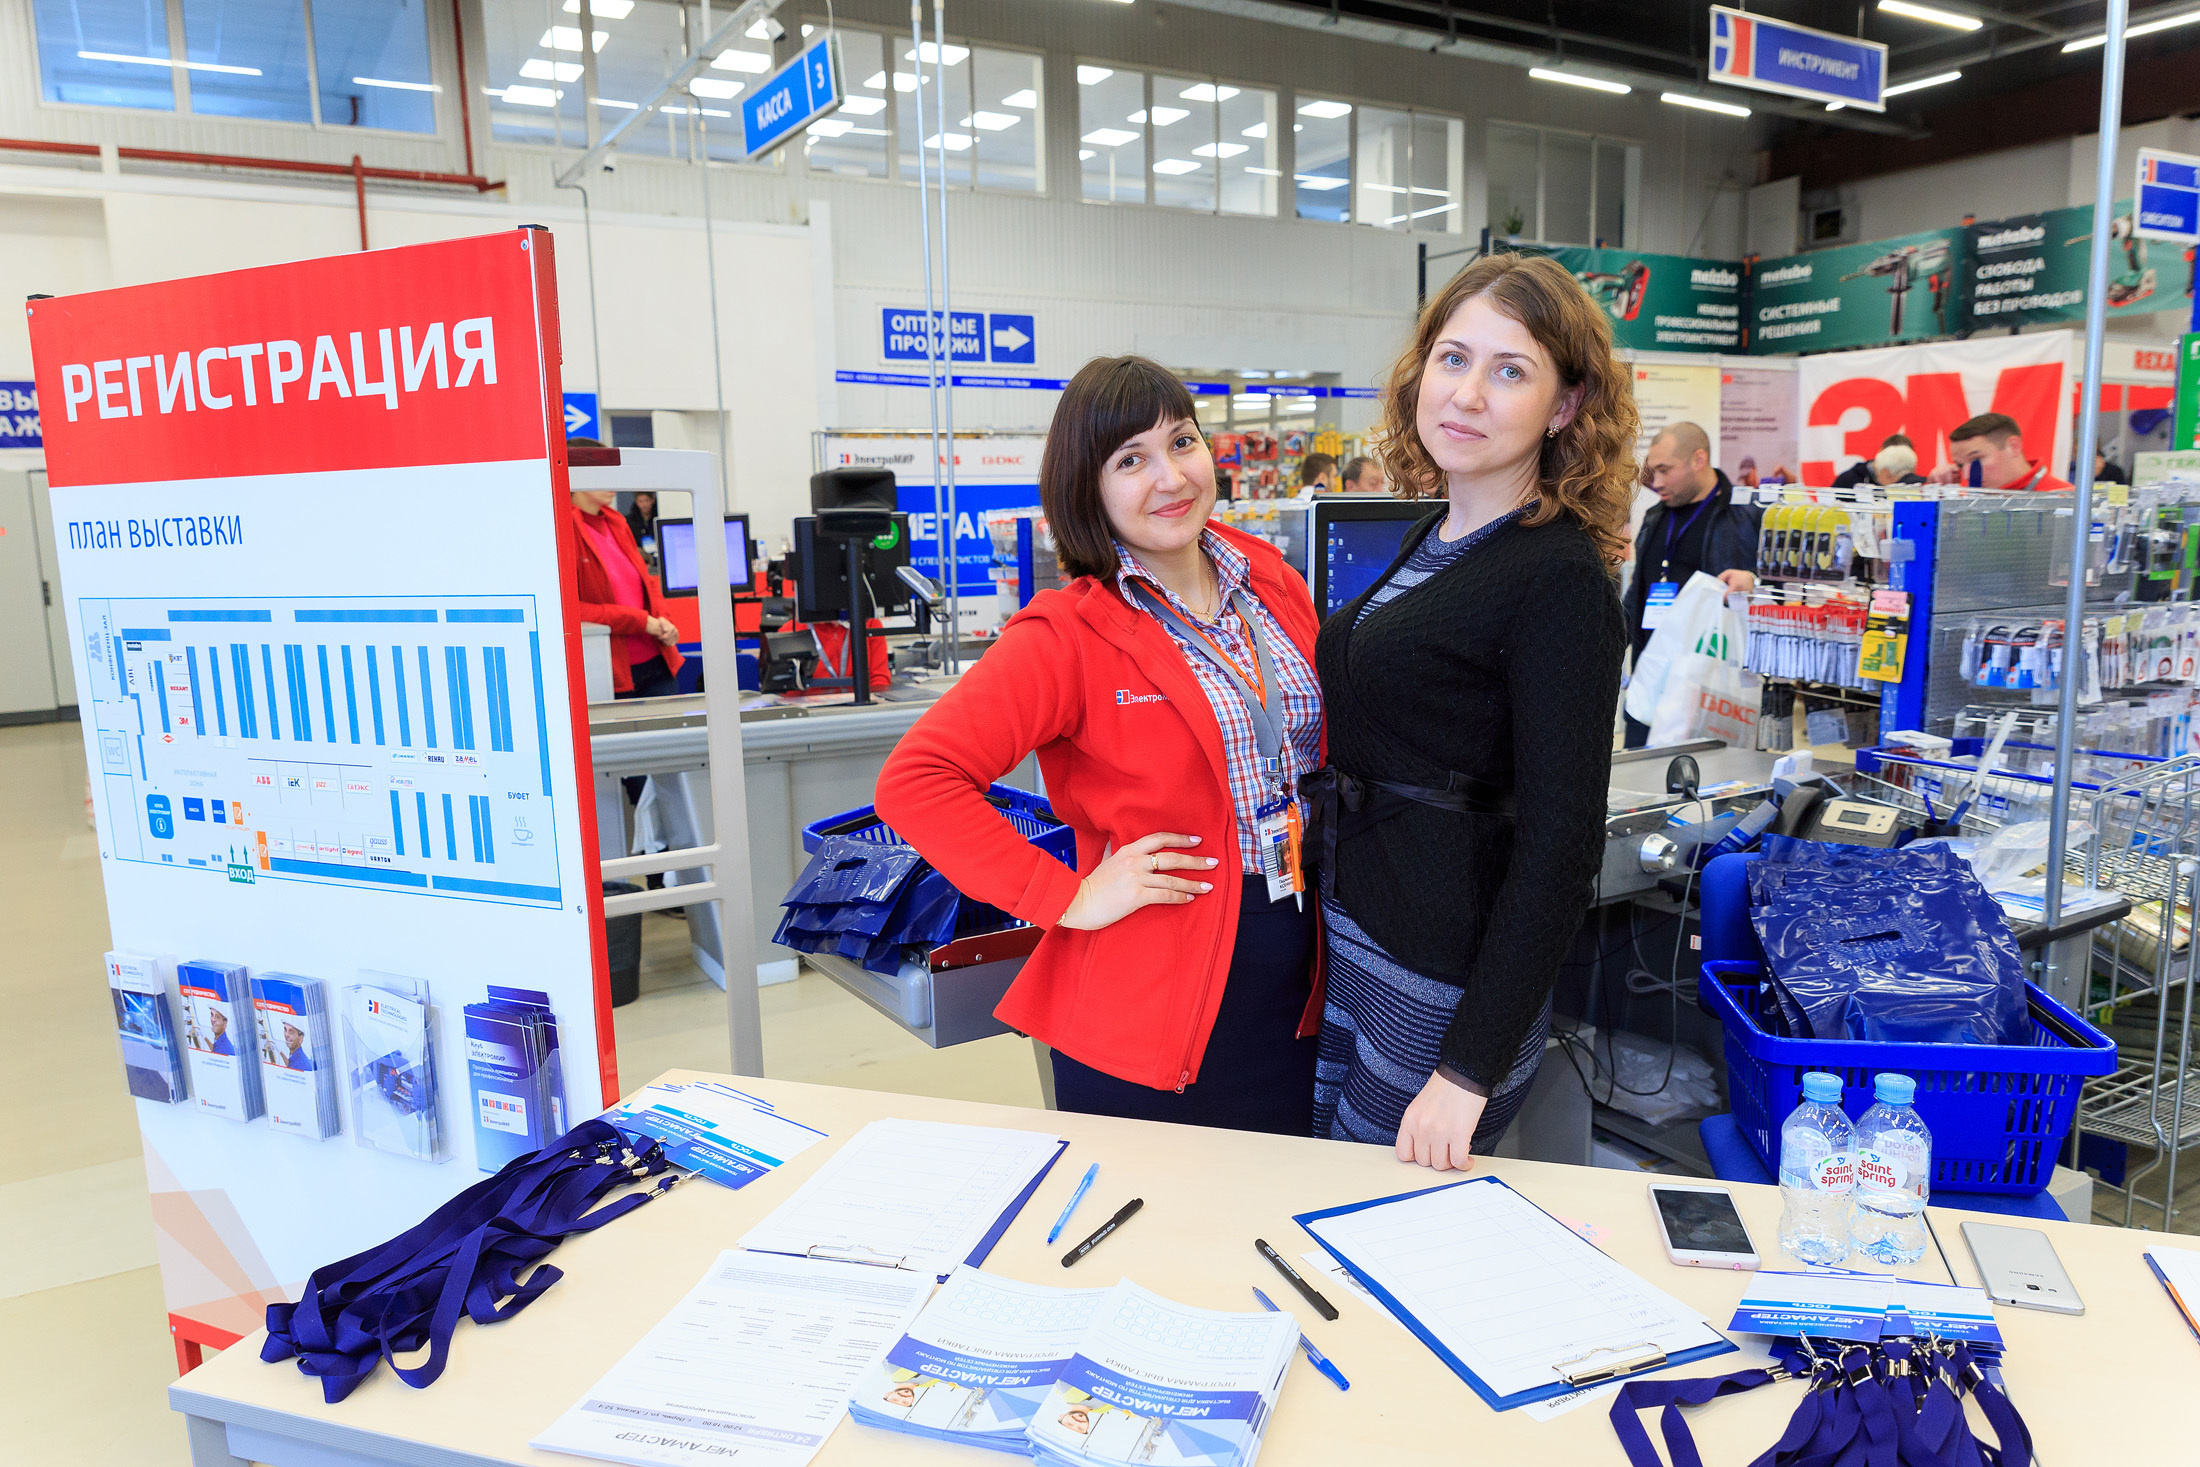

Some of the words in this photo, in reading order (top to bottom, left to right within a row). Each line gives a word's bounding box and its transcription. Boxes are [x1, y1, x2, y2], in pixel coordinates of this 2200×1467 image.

[1778, 47, 1860, 81] ИНСТРУМЕНТ
[756, 87, 793, 131] КАССА
[815, 62, 825, 89] 3
[1977, 226, 2045, 249] metabo
[1761, 264, 1813, 284] metabo
[1976, 257, 2045, 279] СВОБОДА
[1690, 267, 1738, 287] metabo
[1975, 277, 2034, 298] РАБОТЫ
[1759, 297, 1841, 321] СИСТЕМНЫЕ
[1973, 300, 2001, 316] БЕЗ
[2001, 290, 2083, 312] ПРОВОДОВ
[1759, 319, 1821, 340] РЕШЕНИЯ
[61, 316, 498, 424] РЕГИСТРАЦИЯ
[1802, 362, 2063, 487] 3M
[854, 454, 914, 466] ЭлектроМИР
[68, 522, 122, 551] план
[128, 514, 243, 549] выставки
[179, 717, 189, 725] 3M
[256, 776, 271, 785] ABB
[507, 791, 530, 801] БУФЕТ
[369, 837, 388, 847] gauss
[229, 867, 254, 883] ВХОД
[471, 1051, 506, 1061] ЭЛЕКТРОМИР
[683, 1113, 707, 1125] ГОСТЬ
[731, 1143, 754, 1155] ГОСТЬ
[690, 1146, 754, 1174] МЕГАМАСТЕР
[1861, 1159, 1892, 1176] saint
[1826, 1163, 1853, 1175] saint
[1821, 1173, 1854, 1187] spring
[1858, 1167, 1896, 1188] spring
[1750, 1312, 1864, 1325] МЕГАМАСТЕР
[1911, 1321, 1979, 1331] МЕГАМ
[937, 1337, 993, 1355] ВЫСТАВКИ
[915, 1350, 947, 1364] МОНТАЖУ
[947, 1359, 956, 1367] ПО
[954, 1356, 974, 1365] СЕТЕЙ
[995, 1351, 1058, 1359] ПРОГРАММА
[957, 1362, 1006, 1374] СПЕЦИАЛИСТОВ
[975, 1358, 1018, 1369] ИНЖЕНЕРНЫХ
[1106, 1357, 1164, 1382] ВЫСТАВКИ
[920, 1363, 1031, 1386] МЕГАМАСТЕР
[1085, 1369, 1118, 1388] МОНТАЖУ
[1167, 1377, 1236, 1388] ПРОГРАММА
[1125, 1380, 1147, 1391] СЕТЕЙ
[1146, 1385, 1194, 1398] ИНЖЕНЕРНЫХ
[1091, 1385, 1210, 1416] МЕГАМАСТЕР
[1127, 1388, 1180, 1404] СПЕЦИАЛИСТОВ
[746, 1427, 795, 1441] ОКТЯБРЯ
[796, 1435, 812, 1445] 24
[616, 1432, 740, 1457] МЕГАМАСТЕР
